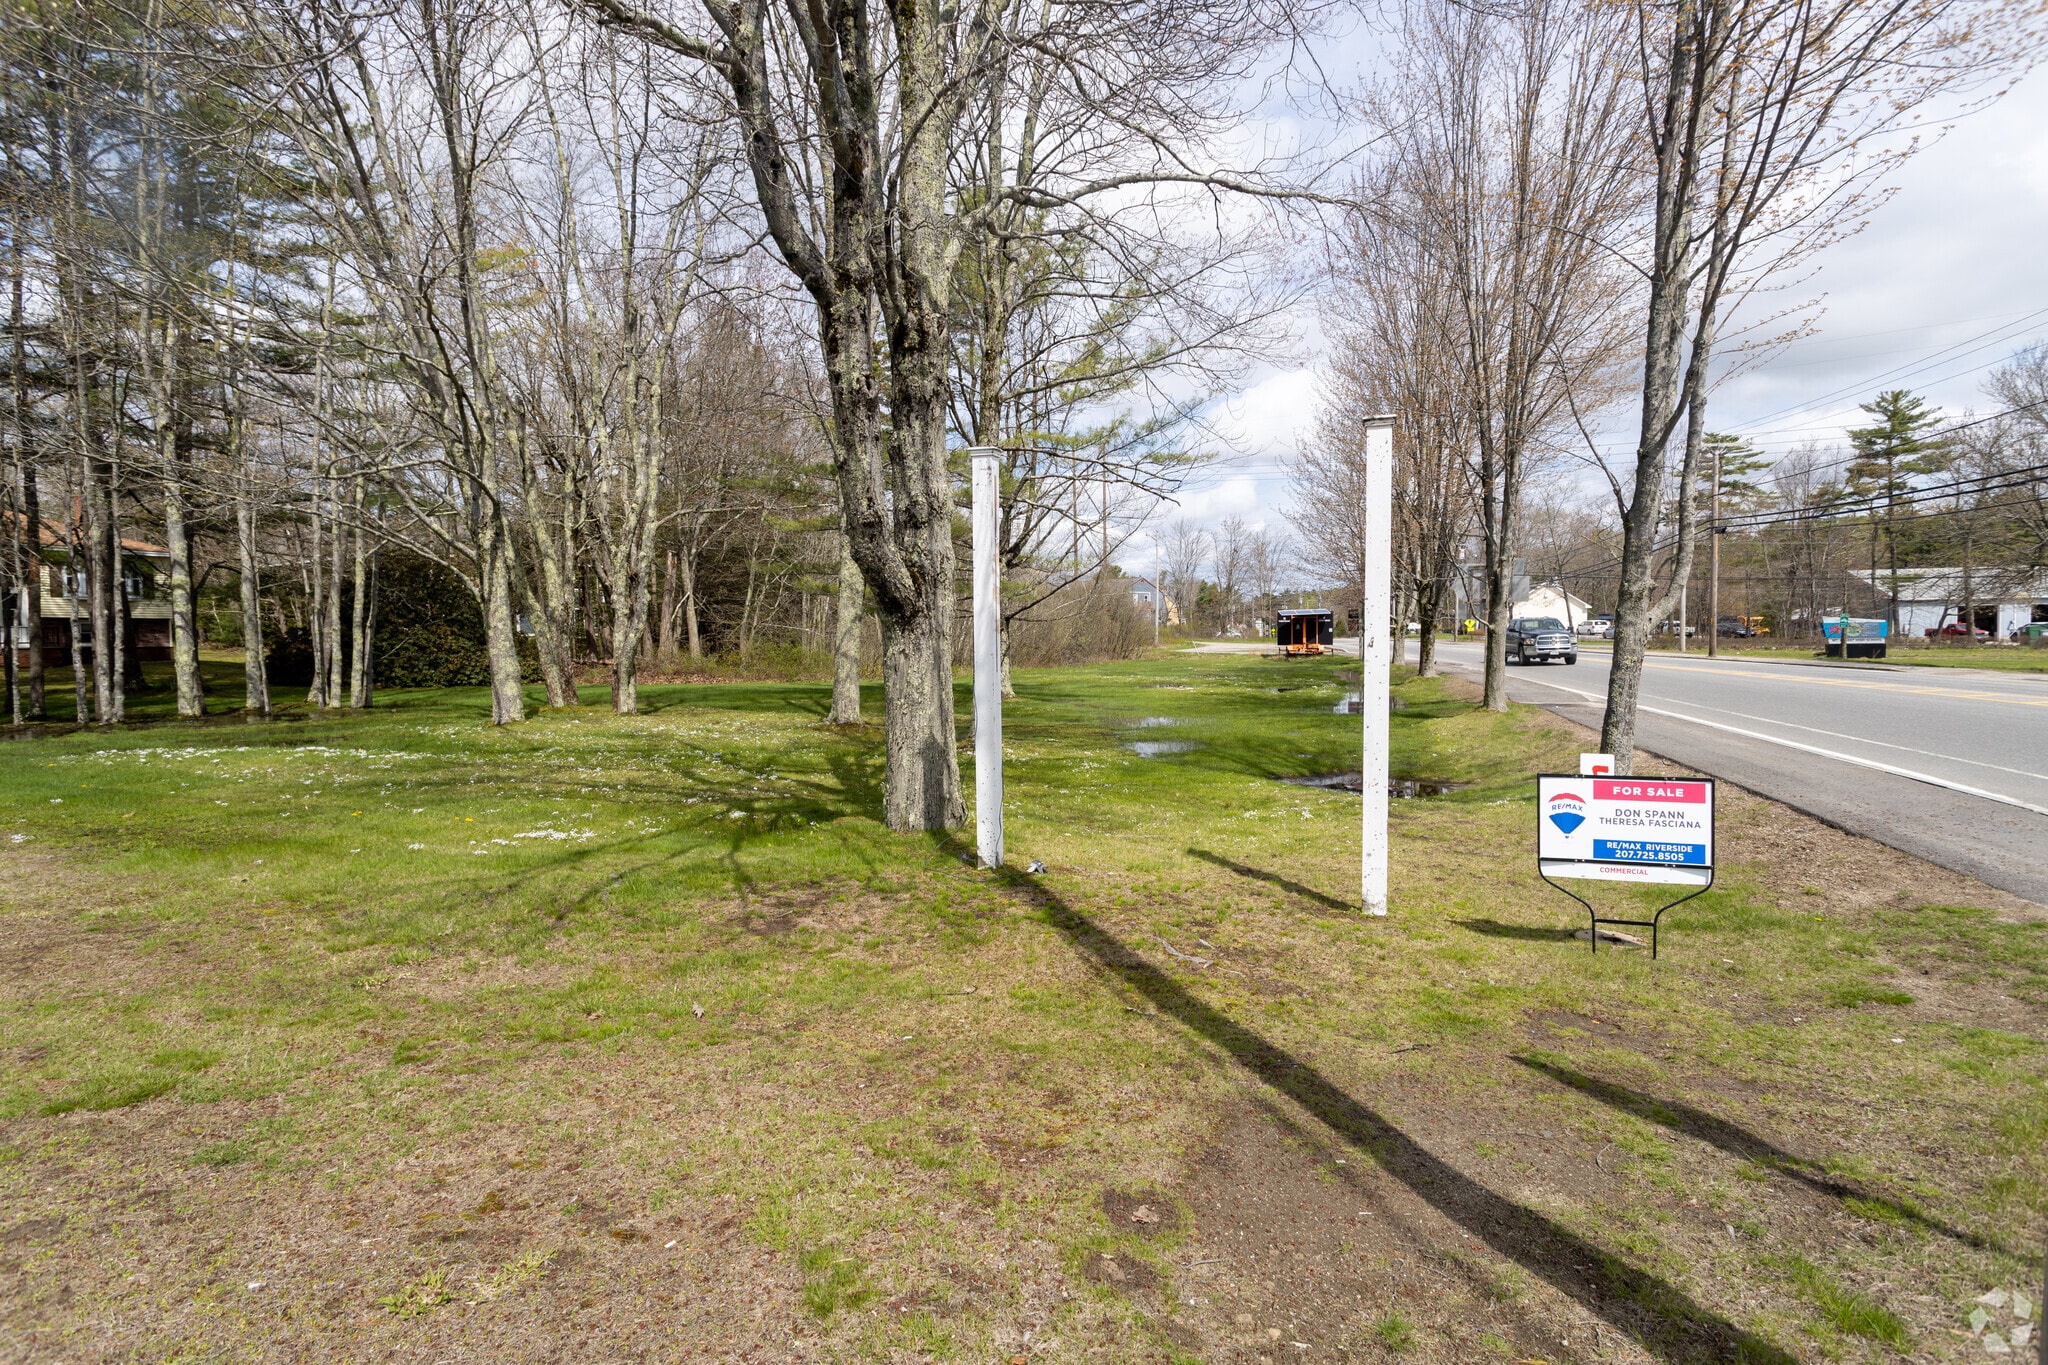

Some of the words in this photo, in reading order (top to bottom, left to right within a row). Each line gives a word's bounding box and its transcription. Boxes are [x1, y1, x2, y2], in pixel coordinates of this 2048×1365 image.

[1612, 786, 1642, 796] FOR
[1646, 787, 1684, 797] SALE
[1551, 803, 1583, 812] RE/MAX
[1615, 808, 1641, 818] DON
[1644, 809, 1685, 819] SPANN
[1599, 817, 1645, 826] THERESA
[1648, 819, 1702, 829] FASCIANA
[1606, 841, 1641, 850] RE/MAX
[1646, 843, 1693, 853] RIVERSIDE
[1615, 850, 1684, 861] 207.725.8505
[1599, 866, 1648, 876] COMMERCIAL
